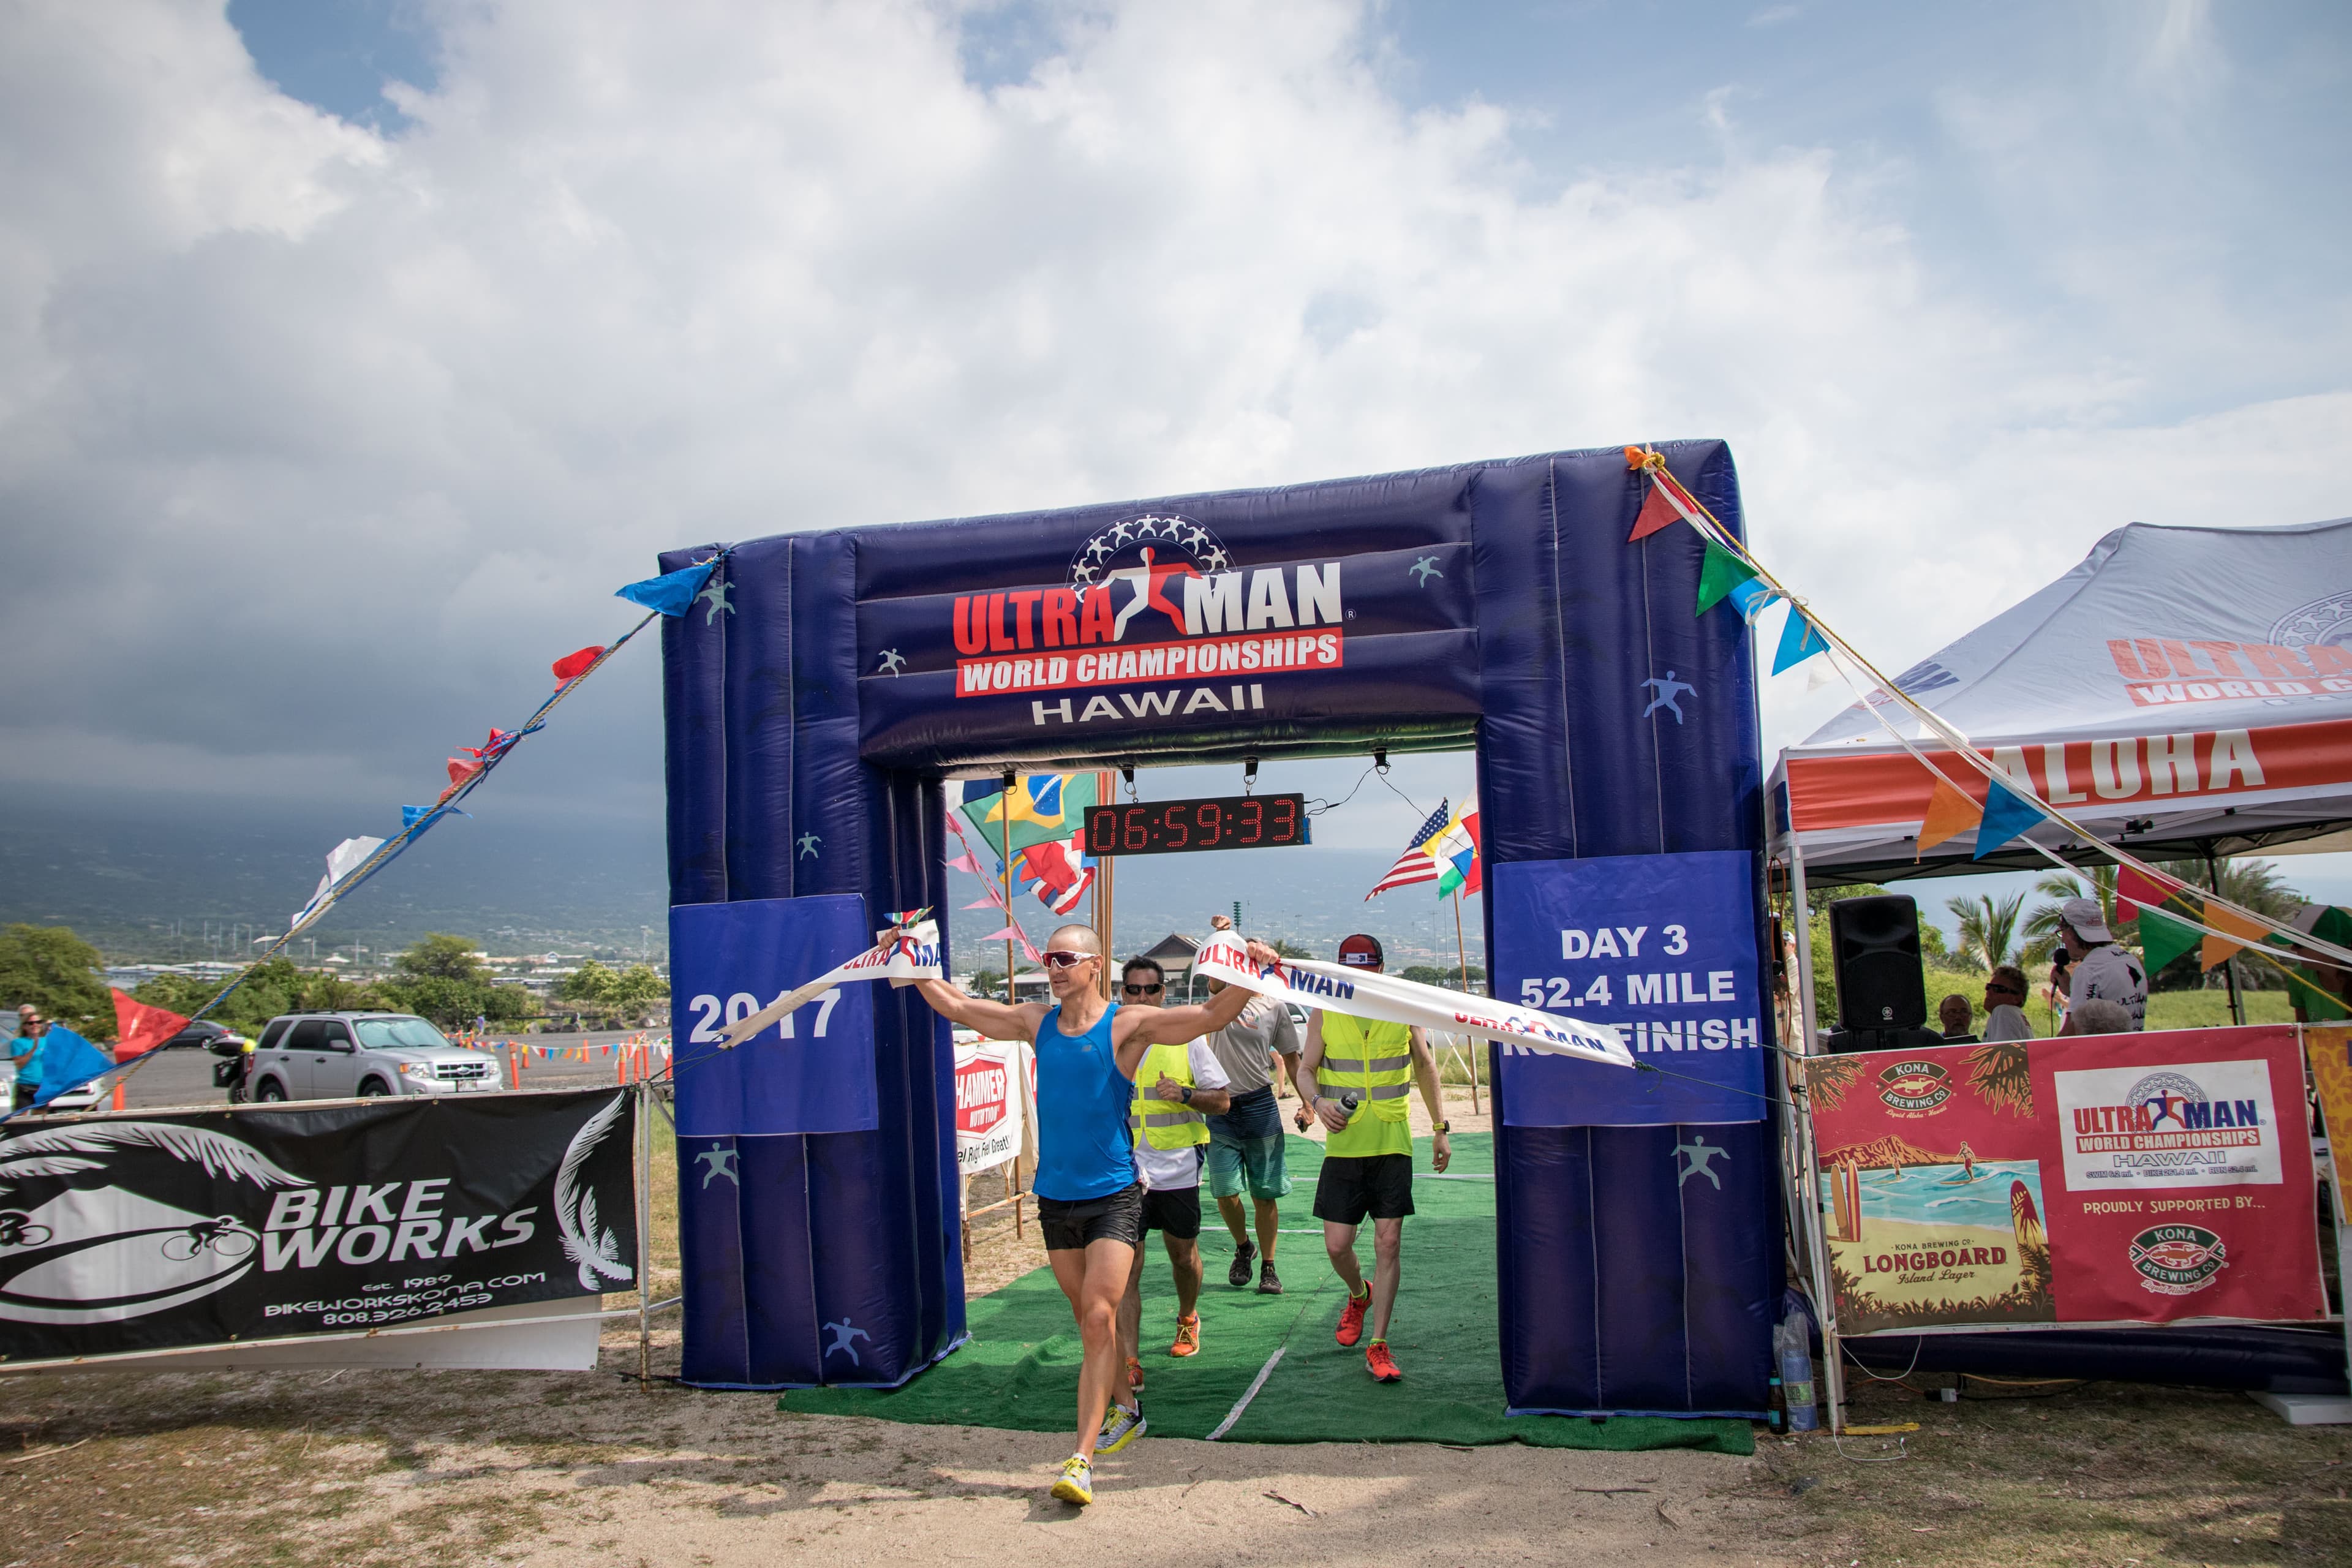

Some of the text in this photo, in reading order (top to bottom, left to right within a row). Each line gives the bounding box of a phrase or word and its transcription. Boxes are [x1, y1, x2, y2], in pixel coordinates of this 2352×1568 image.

[953, 562, 1343, 655] ULTRA MAN
[963, 633, 1337, 692] WORLD CHAMPIONSHIPS
[2106, 638, 2352, 679] ULTRA
[1032, 684, 1264, 726] HAWAII
[2136, 680, 2313, 704] WORLD
[1990, 728, 2266, 804] ALOHA
[1092, 798, 1296, 852] 06:59:33
[1562, 924, 1689, 960] DAY 3
[1198, 943, 1355, 1000] ULTRA MAN
[1520, 971, 1735, 1008] 52.4 MILE
[1894, 1063, 1929, 1076] KONA
[956, 1068, 1006, 1110] HAMMER
[1885, 1093, 1933, 1108] BREWING
[2073, 1099, 2258, 1134] ULTRA MAN
[2079, 1131, 2258, 1152] WORLD CHAMPIONSHIPS
[2114, 1151, 2226, 1167] HAWAII
[264, 1178, 451, 1232] BIKE
[2083, 1200, 2143, 1215] PROUDLY
[2150, 1197, 2230, 1214] SUPPORTED
[262, 1206, 538, 1272] WORKS
[1922, 1240, 1959, 1250] BREWING
[2154, 1228, 2197, 1242] KONA
[1863, 1246, 2007, 1273] LONGBOARD
[2142, 1262, 2201, 1282] BREWING
[404, 1274, 454, 1289] 1989
[1897, 1269, 1975, 1284] Island Lager
[322, 1293, 493, 1325] 808.326.2453
